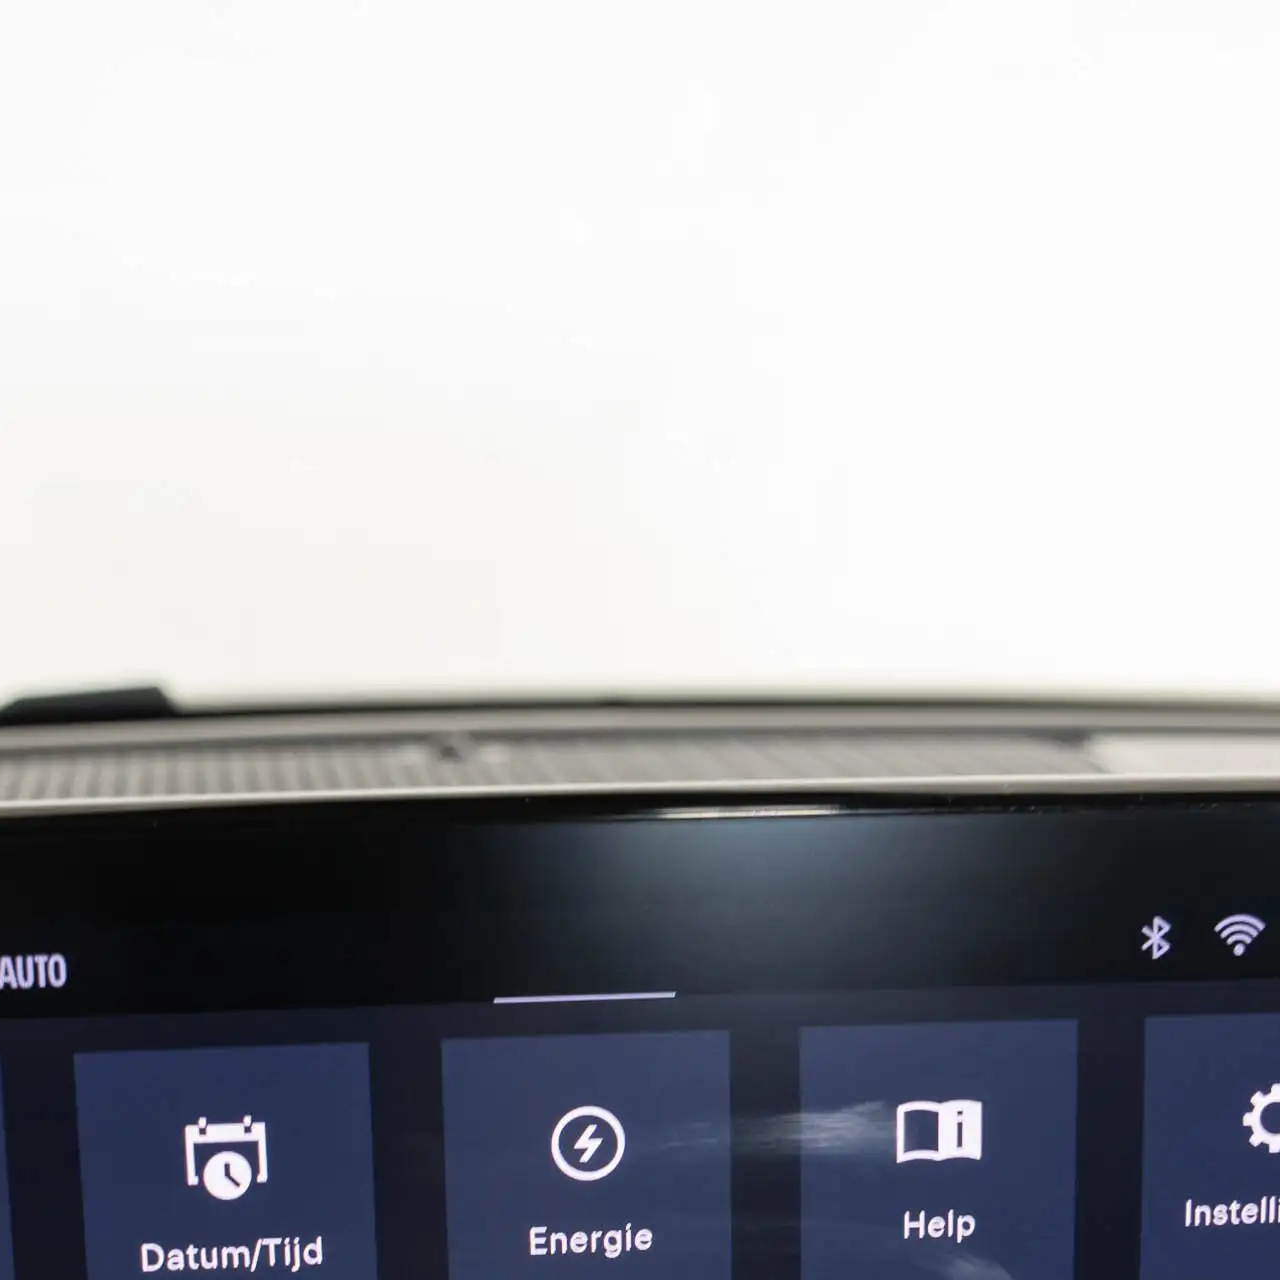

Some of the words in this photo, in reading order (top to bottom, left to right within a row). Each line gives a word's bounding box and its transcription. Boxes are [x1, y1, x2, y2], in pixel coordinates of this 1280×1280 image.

[529, 1222, 653, 1258] Energie
[903, 1209, 976, 1244] Help
[140, 1236, 324, 1273] Datum/Tijd
